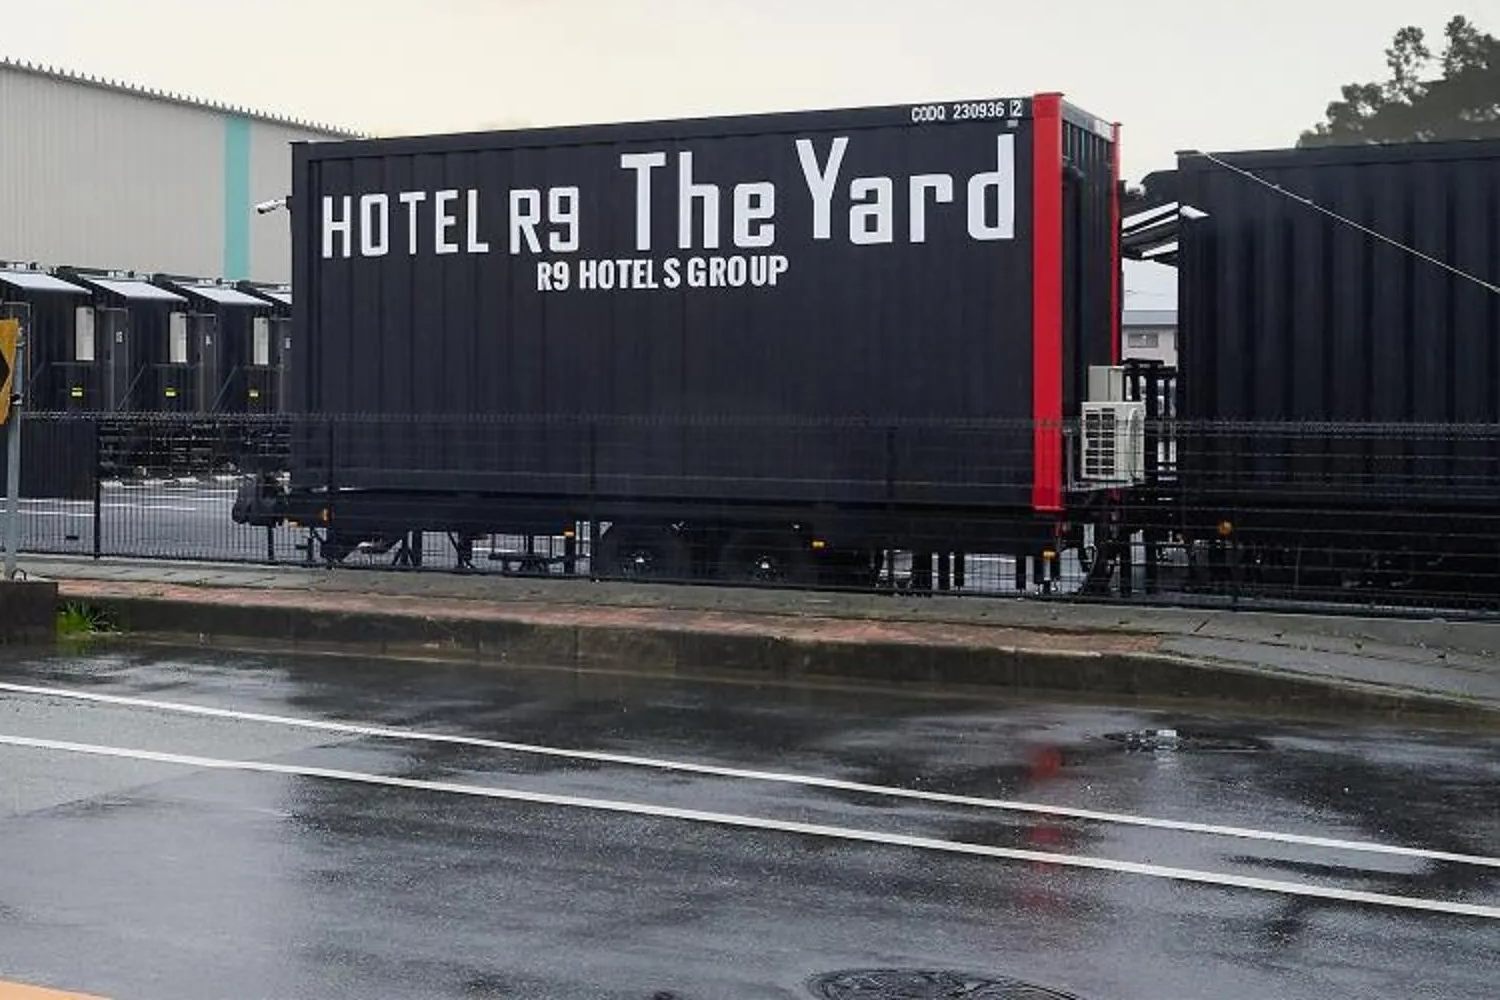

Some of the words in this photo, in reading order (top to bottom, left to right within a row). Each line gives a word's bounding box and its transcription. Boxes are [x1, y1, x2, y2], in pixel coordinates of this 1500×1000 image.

[953, 102, 1004, 119] 230936
[1010, 100, 1022, 117] 2
[322, 189, 488, 259] HOTEL
[510, 186, 580, 255] R9
[621, 151, 775, 250] The
[796, 134, 1014, 244] Yard
[537, 261, 570, 291] R9
[579, 257, 681, 290] HOTELS
[688, 255, 788, 287] GROUP
